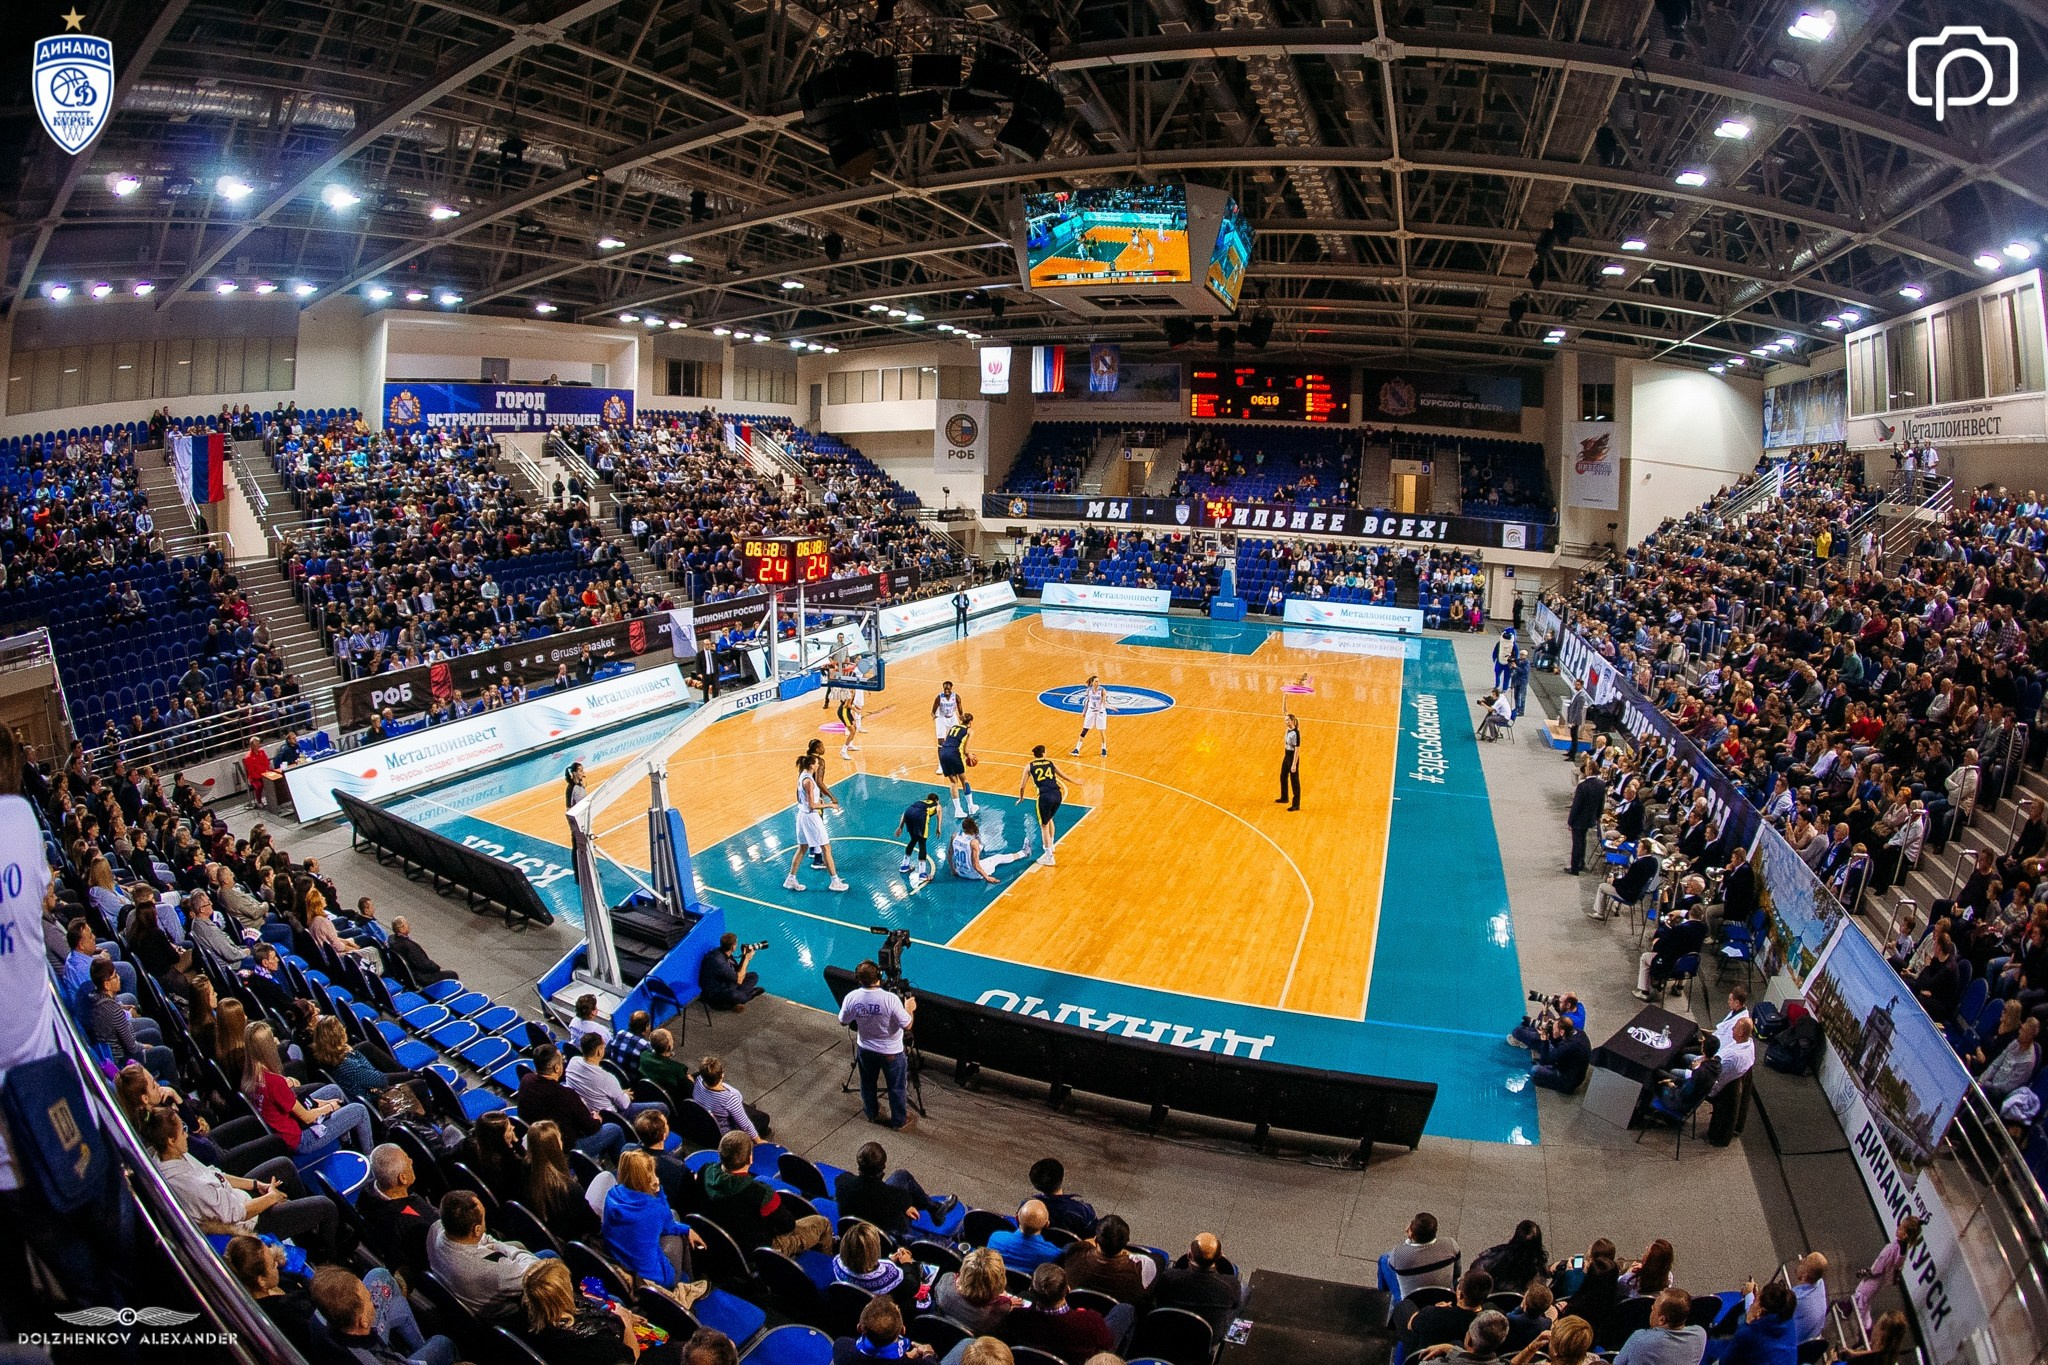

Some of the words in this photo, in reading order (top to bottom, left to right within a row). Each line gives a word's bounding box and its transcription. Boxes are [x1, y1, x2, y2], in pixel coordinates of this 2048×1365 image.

[496, 391, 545, 410] ГОРОД
[1250, 395, 1280, 406] 06:18
[1420, 398, 1461, 409] КУРСКОЙ
[427, 410, 529, 427] УСТРЕМЛЕННЫЙ
[533, 414, 541, 426] В
[546, 414, 601, 426] БУДУЩЕЕ!
[1902, 416, 2002, 441] Металлоинвест
[948, 449, 975, 460] РФБ
[1124, 450, 1131, 459] D
[1422, 464, 1430, 474] D
[1086, 501, 1130, 519] МЫ
[1220, 507, 1346, 532] ИЛЬНЕЕ
[1363, 516, 1448, 539] ВСЕХ!
[1506, 567, 1513, 576] F
[1092, 590, 1160, 603] Металлоинвест
[692, 610, 733, 626] ЕМПИОНАТ
[733, 603, 765, 617] РОССИИ
[1340, 608, 1413, 622] Металлоинвест
[371, 682, 413, 710] РФБ
[586, 677, 671, 709] Металлоинвест
[736, 688, 773, 709] GARED
[950, 727, 960, 737] 11
[1408, 694, 1450, 784] #здесьбаскетбол
[384, 726, 497, 770] Металлоинвест
[390, 768, 423, 783] Ресурсы
[1035, 767, 1053, 781] 24
[1854, 1120, 1911, 1227] ДИНАМО
[1906, 1235, 1952, 1332] КУРСК
